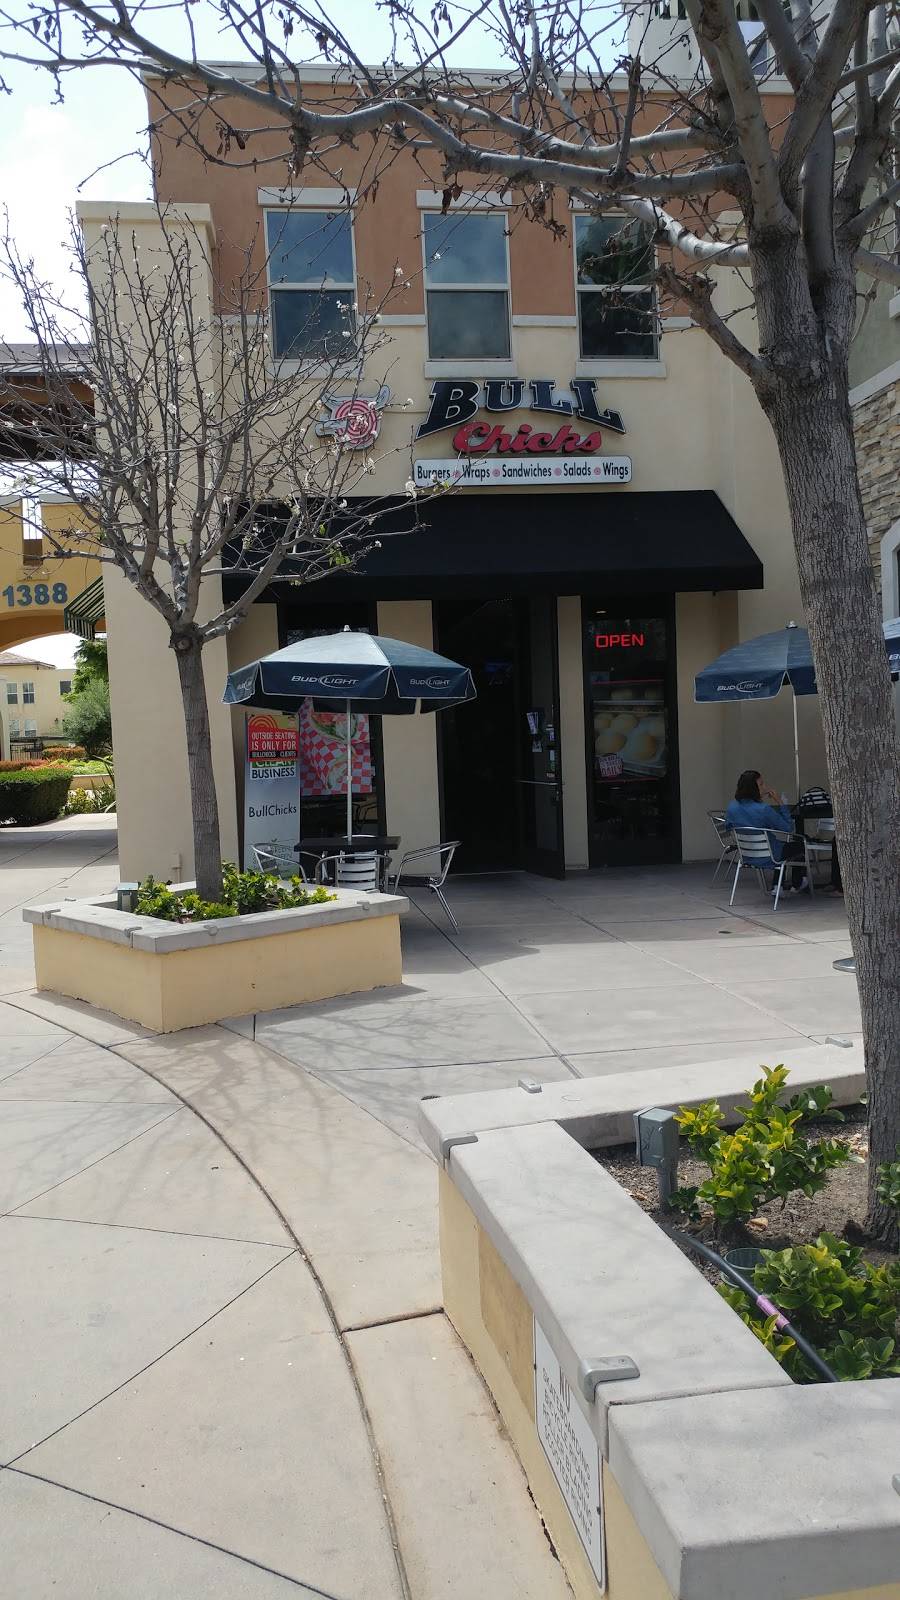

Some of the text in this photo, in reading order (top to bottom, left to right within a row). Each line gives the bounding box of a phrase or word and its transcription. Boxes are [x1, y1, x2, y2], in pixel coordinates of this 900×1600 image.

[414, 379, 626, 442] BULL
[452, 421, 602, 453] Chicks
[462, 464, 490, 481] Wraps
[502, 462, 552, 478] Sandwiches
[563, 461, 592, 477] Salads
[602, 462, 629, 479] Wings
[2, 582, 68, 607] 1388
[595, 634, 645, 648] OPEN
[291, 675, 359, 685] BUD LIGHT
[251, 741, 297, 750] IS ONLY FOR
[251, 767, 295, 779] BUSINESS
[248, 801, 297, 818] BullChicks
